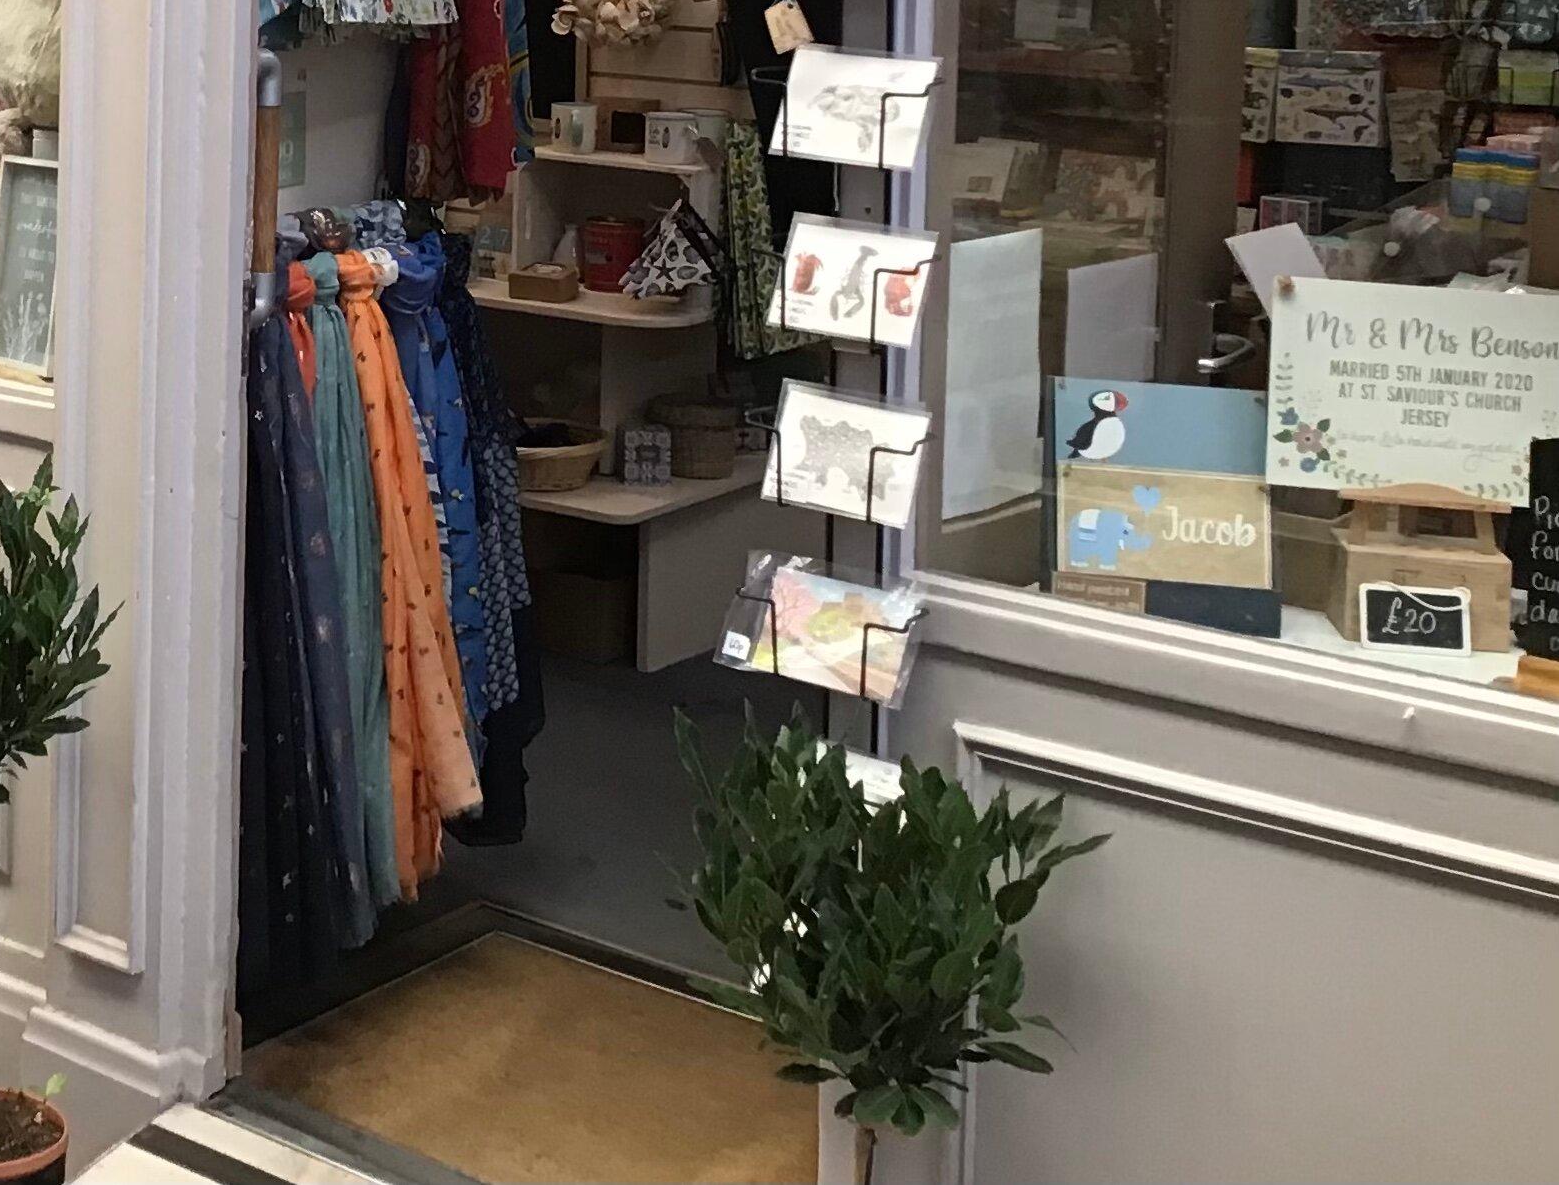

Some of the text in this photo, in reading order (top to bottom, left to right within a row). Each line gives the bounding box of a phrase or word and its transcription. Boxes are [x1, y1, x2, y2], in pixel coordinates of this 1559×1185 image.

[1306, 311, 1356, 349] Mr
[1368, 317, 1388, 350] &
[1399, 317, 1459, 356] Mrs
[1329, 360, 1534, 392] MARRIED 5TH JANUARY 2020
[1338, 382, 1354, 398] AT
[1465, 391, 1522, 412] CHURCH
[1400, 408, 1450, 427] JERSEY
[1162, 506, 1257, 547] Jacob
[1382, 597, 1437, 635] £20
